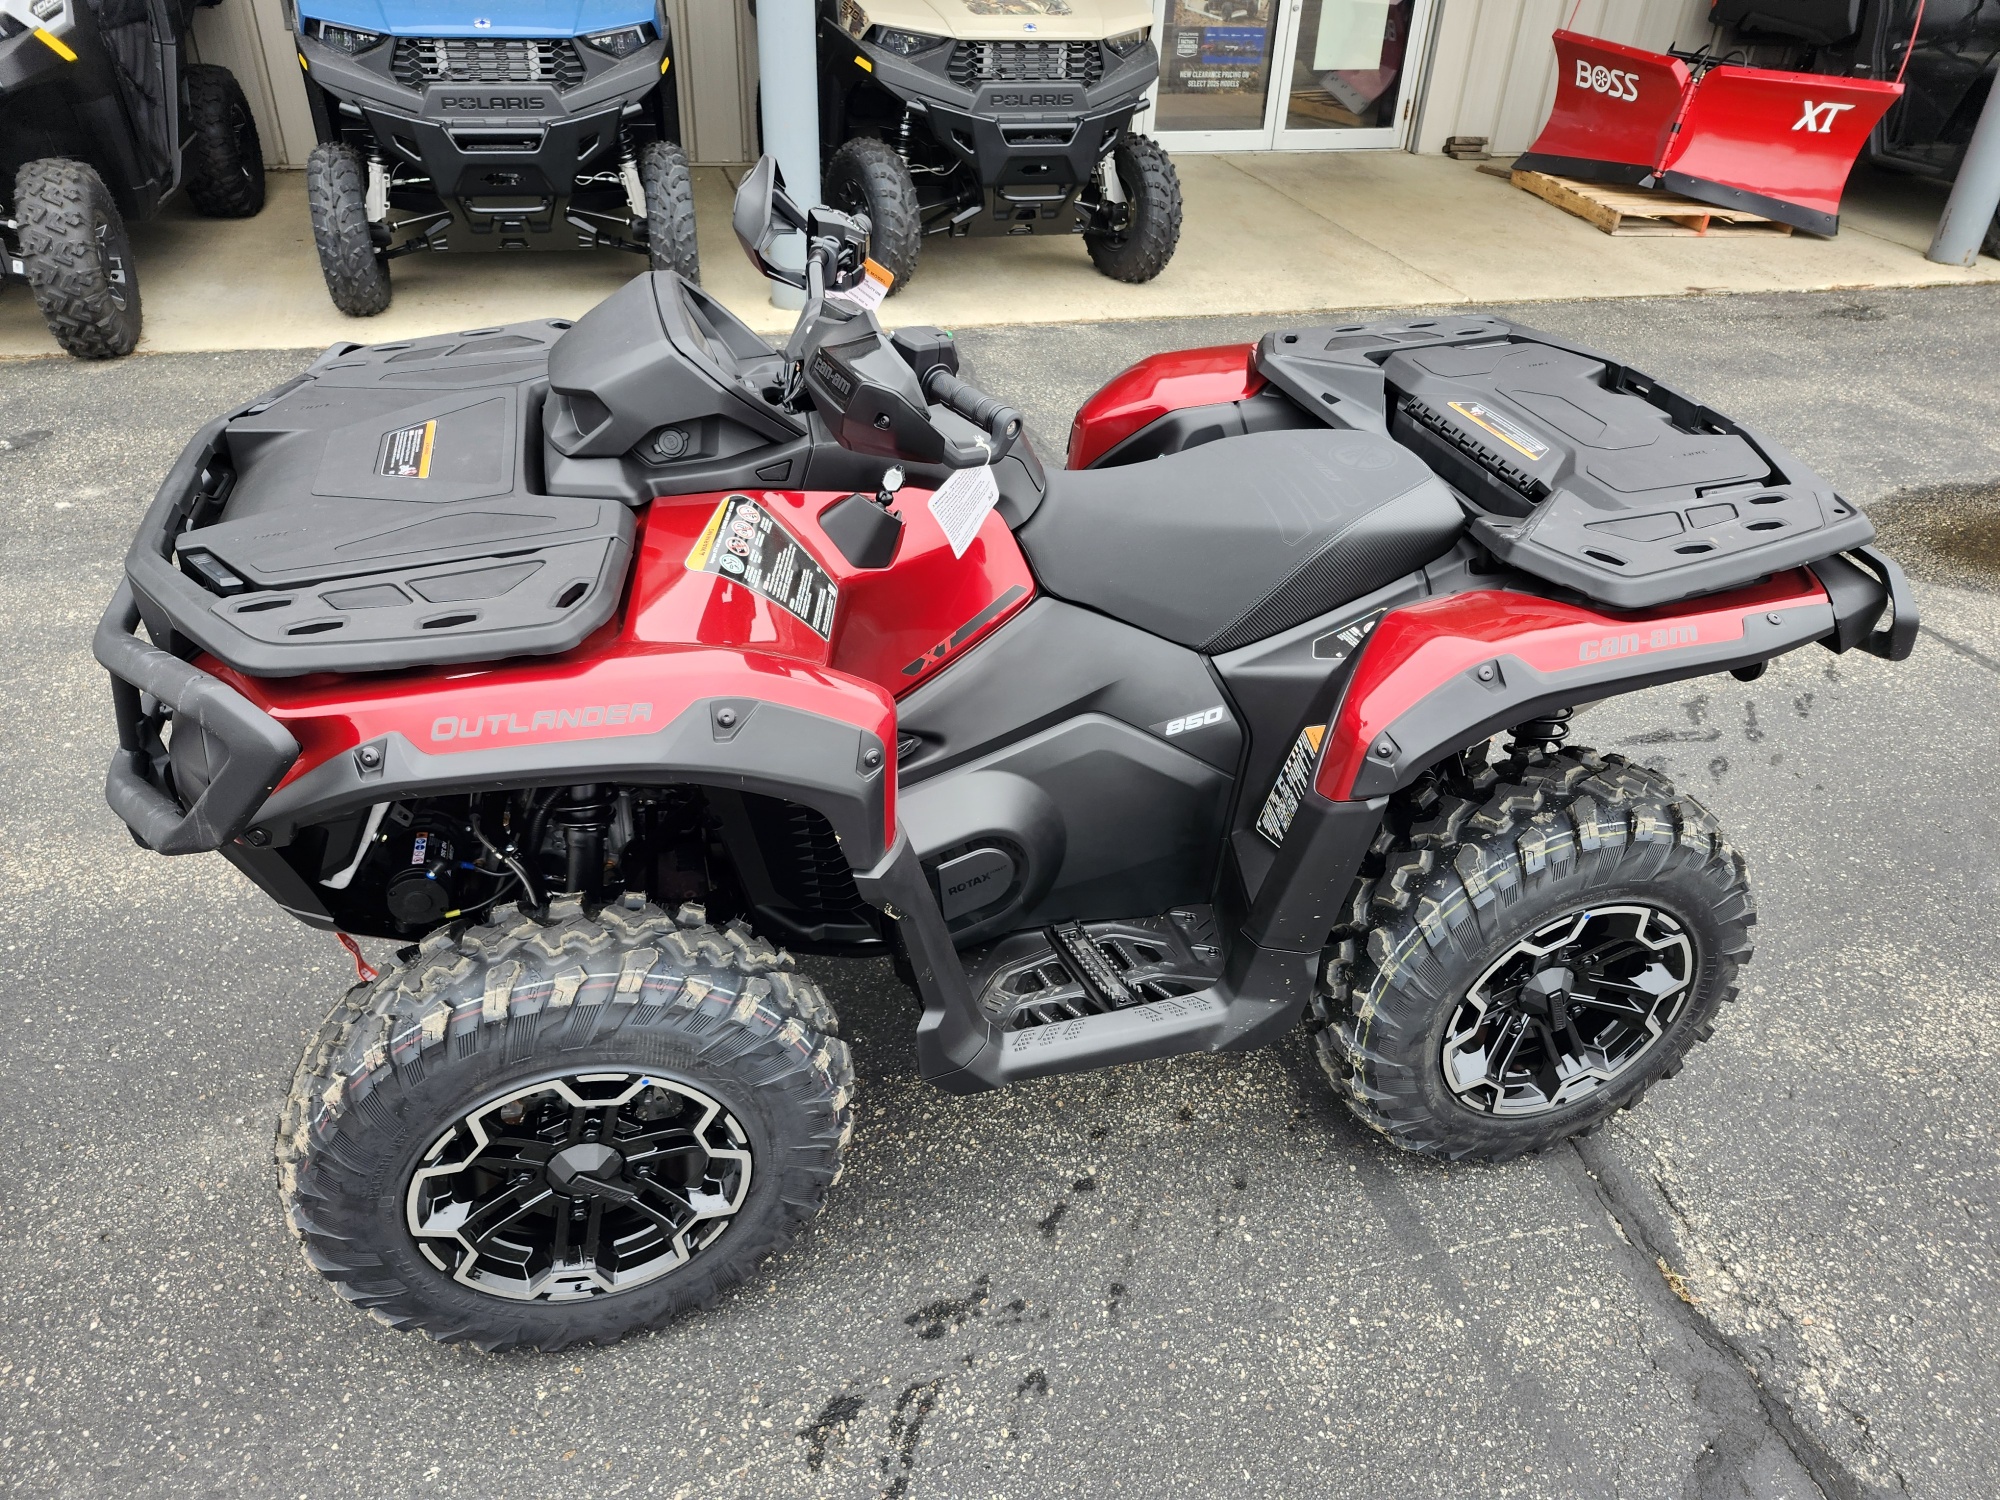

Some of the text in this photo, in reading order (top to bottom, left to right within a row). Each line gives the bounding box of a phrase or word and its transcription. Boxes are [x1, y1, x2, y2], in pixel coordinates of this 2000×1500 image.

[1576, 60, 1639, 102] BOSS
[441, 97, 546, 110] POLARIS
[990, 94, 1074, 107] POLARIS
[1791, 101, 1856, 133] XT
[814, 357, 851, 395] can-am
[920, 631, 956, 670] XT
[1579, 625, 1698, 661] can-am
[431, 702, 653, 741] OUTLANDER
[1165, 707, 1224, 736] 850
[948, 872, 991, 896] ROTAX
